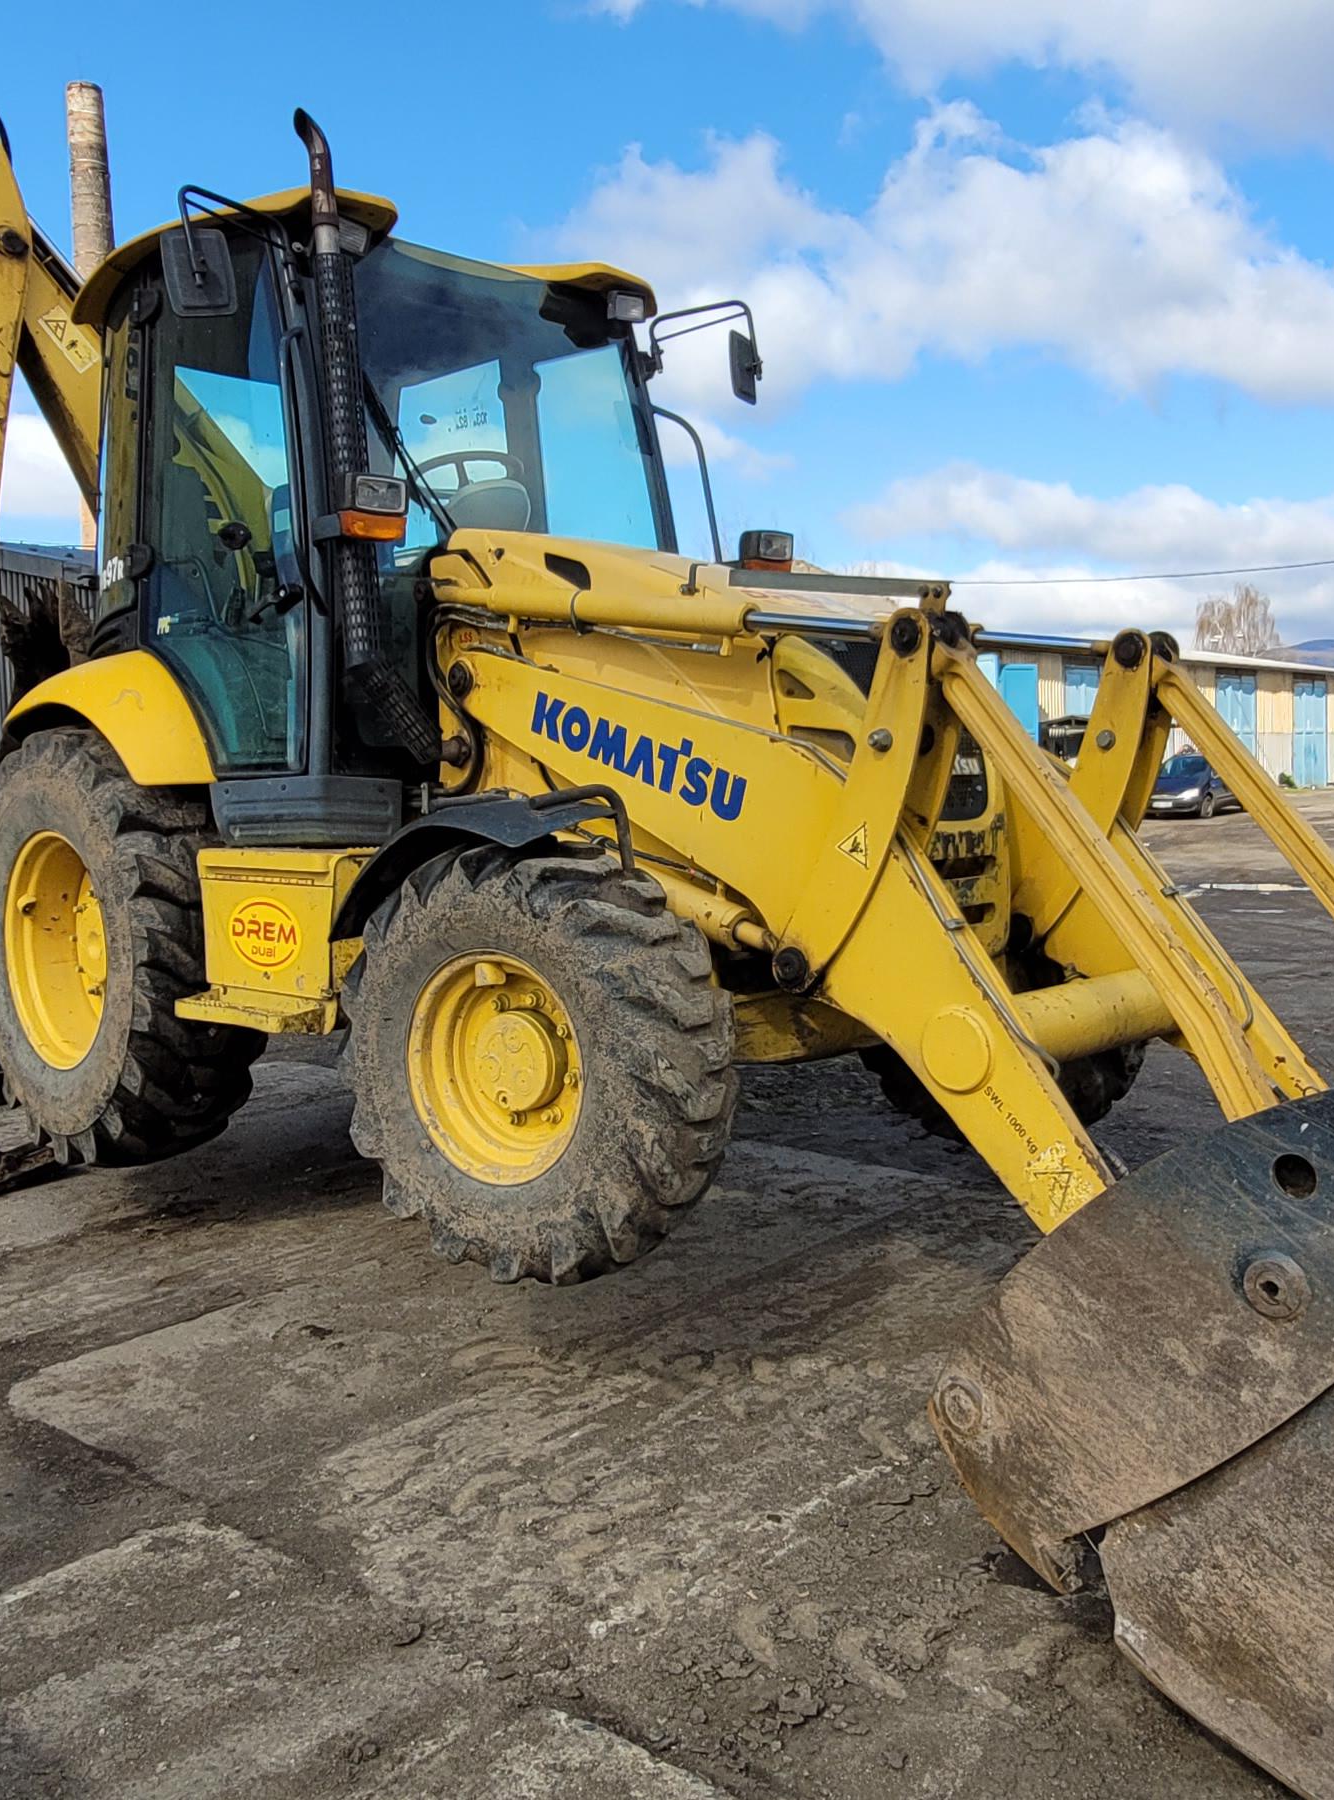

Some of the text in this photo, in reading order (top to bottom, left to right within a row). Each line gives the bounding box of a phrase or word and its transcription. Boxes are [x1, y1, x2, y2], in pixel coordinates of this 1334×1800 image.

[531, 690, 748, 821] KOMATSU
[232, 913, 298, 946] DŘEM
[984, 1086, 1039, 1154] SWL 1000 kg
